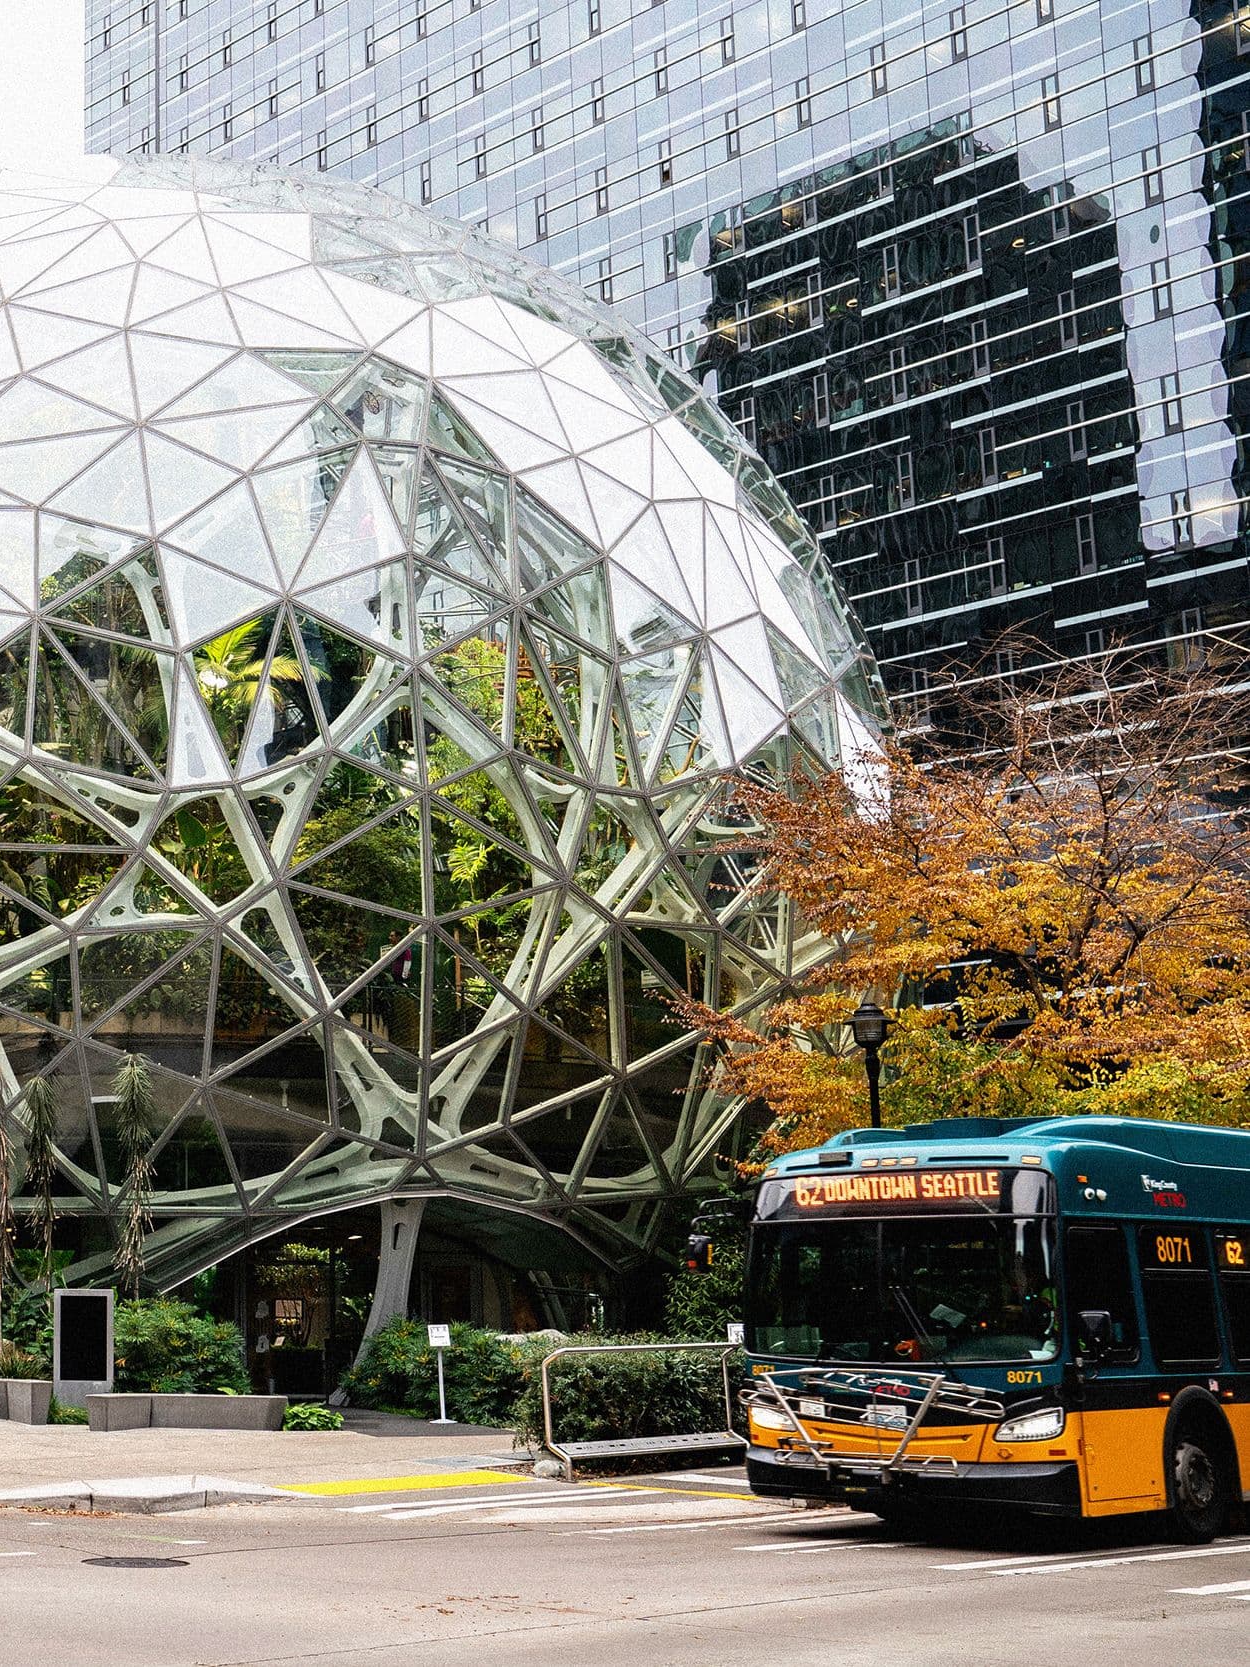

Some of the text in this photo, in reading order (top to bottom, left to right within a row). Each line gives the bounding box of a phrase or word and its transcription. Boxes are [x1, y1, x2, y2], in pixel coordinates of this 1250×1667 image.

[795, 1172, 1000, 1206] 62 DOWNTOWN SEATTLE
[1152, 1191, 1187, 1208] METRO
[1156, 1236, 1192, 1263] 8071
[1225, 1240, 1245, 1265] 62
[1007, 1371, 1042, 1383] 8071
